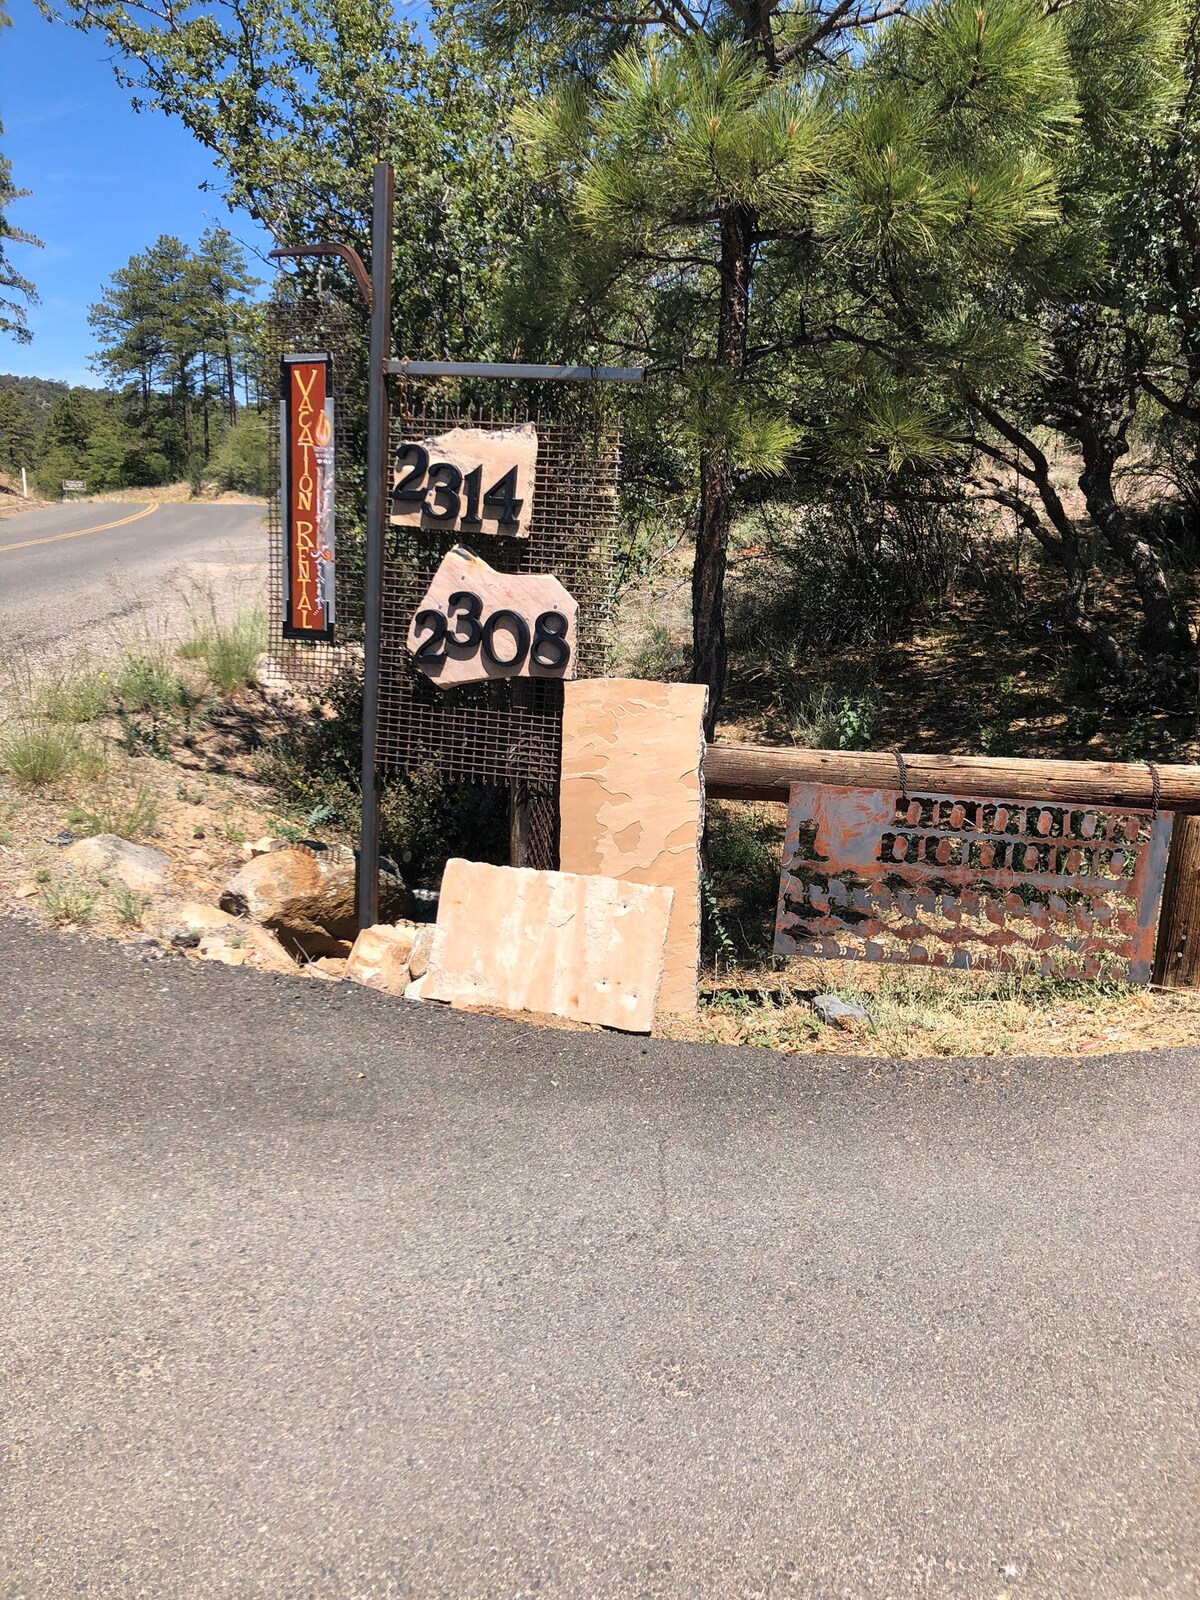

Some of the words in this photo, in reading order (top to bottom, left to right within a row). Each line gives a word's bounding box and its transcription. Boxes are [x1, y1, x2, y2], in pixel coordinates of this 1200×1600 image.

[293, 369, 318, 511] VACATION
[392, 443, 524, 526] 2314
[295, 520, 314, 630] RENTAL
[413, 591, 571, 670] 2308
